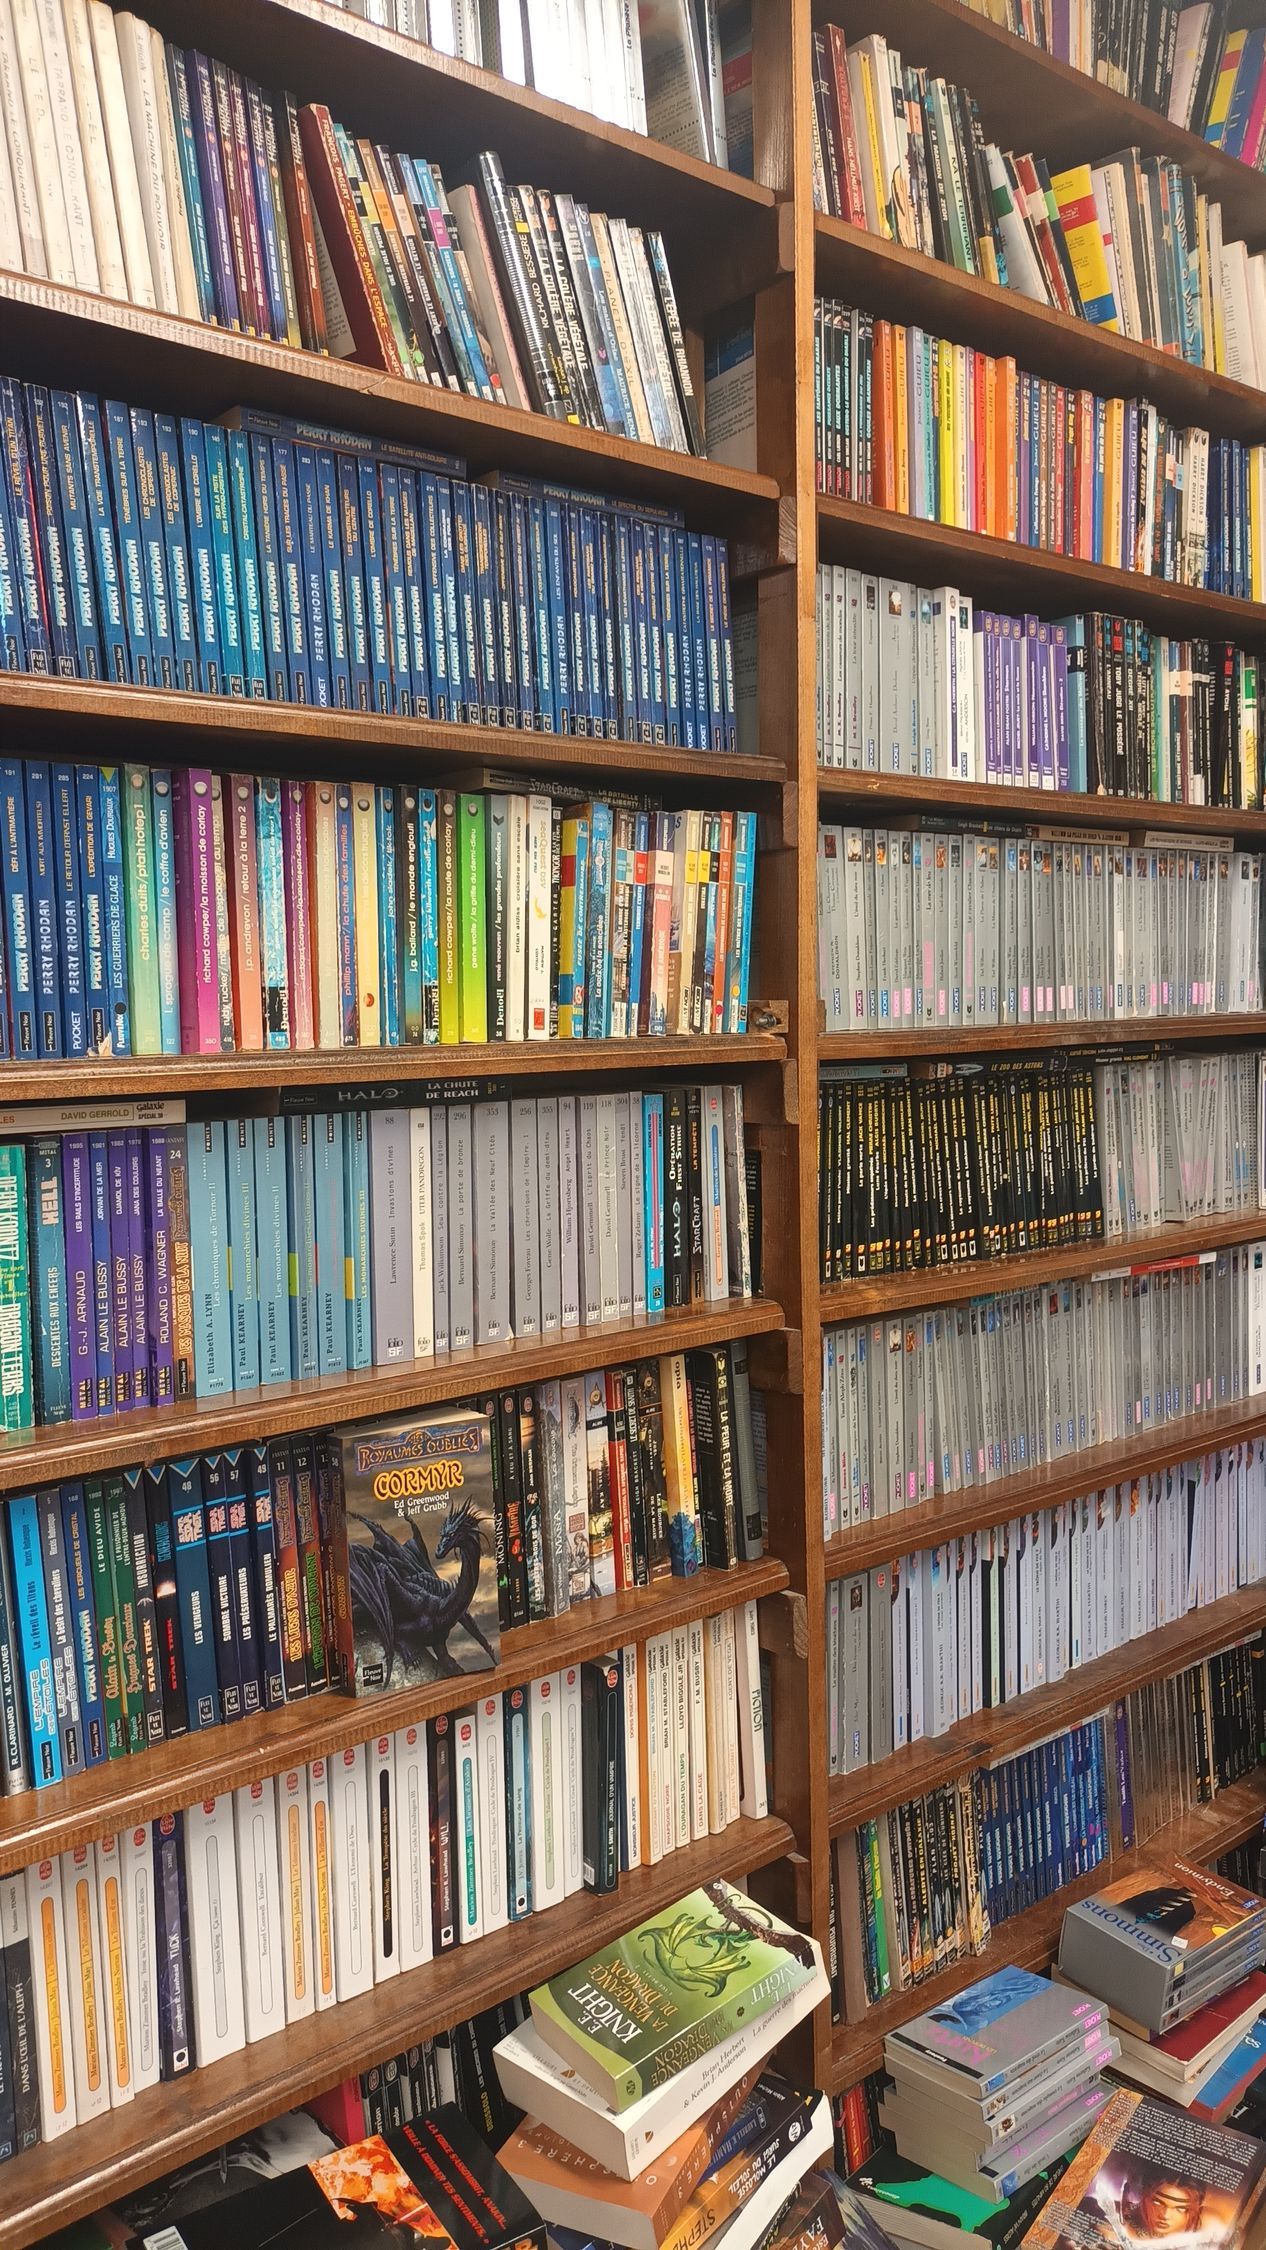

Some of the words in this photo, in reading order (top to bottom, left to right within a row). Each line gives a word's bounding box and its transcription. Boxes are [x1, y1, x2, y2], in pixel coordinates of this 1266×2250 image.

[931, 130, 937, 141] LA
[932, 145, 943, 179] MAISON
[938, 183, 944, 195] DE
[330, 167, 350, 200] PAGERY
[362, 261, 374, 285] DANS
[370, 288, 388, 328] L'ESPACE
[556, 259, 567, 275] LA
[559, 277, 576, 316] COLÈRE
[566, 320, 588, 370] VÉGÉTALE
[671, 331, 682, 344] DE
[674, 348, 694, 396] RHIANNON
[61, 425, 71, 453] AVENIR
[296, 424, 327, 442] PERRY
[329, 429, 372, 450] RHODAN
[65, 455, 73, 475] SANS
[68, 477, 77, 510] MUTANTS
[72, 527, 88, 583] RHODAN
[78, 585, 93, 626] PERRY
[1116, 710, 1122, 719] LE
[1116, 722, 1124, 755] POSSÉDÉ
[61, 788, 69, 815] ELLERT
[196, 805, 207, 837] corlay
[198, 839, 206, 852] de
[65, 850, 73, 879] RETOUR
[199, 854, 208, 893] moisson
[67, 881, 73, 891] LE
[109, 875, 119, 903] GLACE
[12, 894, 27, 948] RHODAN
[65, 900, 77, 951] RHODAN
[110, 906, 119, 919] DE
[112, 921, 122, 969] GUERRIERS
[17, 950, 29, 992] PERRY
[68, 954, 80, 994] PERRY
[113, 971, 123, 988] LES
[202, 949, 212, 983] richard
[72, 1012, 81, 1049] POCKET
[136, 1102, 165, 1112] Galaxie
[339, 1088, 399, 1101] HALO
[444, 1090, 479, 1098] REACH
[61, 1111, 87, 1121] DAVID
[89, 1109, 129, 1119] GERROLD
[75, 1219, 83, 1232] LES
[242, 1196, 250, 1228] divines
[389, 1227, 397, 1246] Sutin
[672, 1200, 681, 1258] HALO
[156, 1230, 167, 1278] WAGNER
[244, 1232, 252, 1281] monarchies
[390, 1248, 398, 1284] Lawrence
[47, 1267, 59, 1299] ENFERS
[97, 1260, 108, 1298] BUSSY
[158, 1282, 168, 1293] C.
[49, 1301, 60, 1317] AUX
[75, 1270, 87, 1322] ARNAUD
[98, 1301, 108, 1316] LE
[1, 1302, 22, 1351] DRAGON
[99, 1318, 110, 1353] ALAIN
[159, 1299, 170, 1344] ROLAND
[238, 1303, 246, 1344] KEARNEY
[49, 1320, 61, 1367] DESCENTES
[238, 1347, 247, 1367] Paul
[4, 1354, 23, 1395] TEARS
[374, 1460, 465, 1501] CORMYR
[394, 1500, 405, 1509] Ed
[407, 1491, 450, 1507] Greenwood
[397, 1508, 405, 1517] &
[407, 1505, 421, 1516] Jeff
[423, 1502, 447, 1514] Grubb
[70, 1512, 80, 1537] CRISTAL
[93, 1507, 102, 1535] AVIDE
[74, 1539, 81, 1549] DE
[96, 1538, 104, 1560] DIEU
[133, 1533, 149, 1588] INSURRECTION
[75, 1551, 84, 1585] CERCUEILS
[98, 1563, 106, 1572] LE
[263, 1553, 273, 1592] ROMULIEN
[218, 1575, 229, 1608] VICTOIRE
[238, 1568, 250, 1624] PRÉSERVATEURS
[191, 1591, 202, 1629] VENGEURS
[221, 1609, 231, 1641] SOMBRE
[142, 1620, 153, 1655] TREK
[195, 1631, 203, 1644] LES
[242, 1626, 251, 1640] LES
[268, 1633, 277, 1641] LE
[146, 1657, 156, 1692] STAR
[677, 1664, 683, 1672] JR
[1174, 1862, 1234, 1898] Endymion
[169, 1934, 180, 1960] TUCK
[1081, 1900, 1182, 1963] Simmons
[588, 1963, 653, 2024] VENGEANCE
[610, 1959, 664, 2005] DRAGON
[567, 1982, 643, 2044] KNIGHT
[17, 2025, 27, 2037] DE
[702, 2062, 720, 2081] Brian
[719, 2037, 745, 2064] Herbert
[20, 2064, 32, 2093] DANS
[737, 2162, 768, 2200] MOLOSSE
